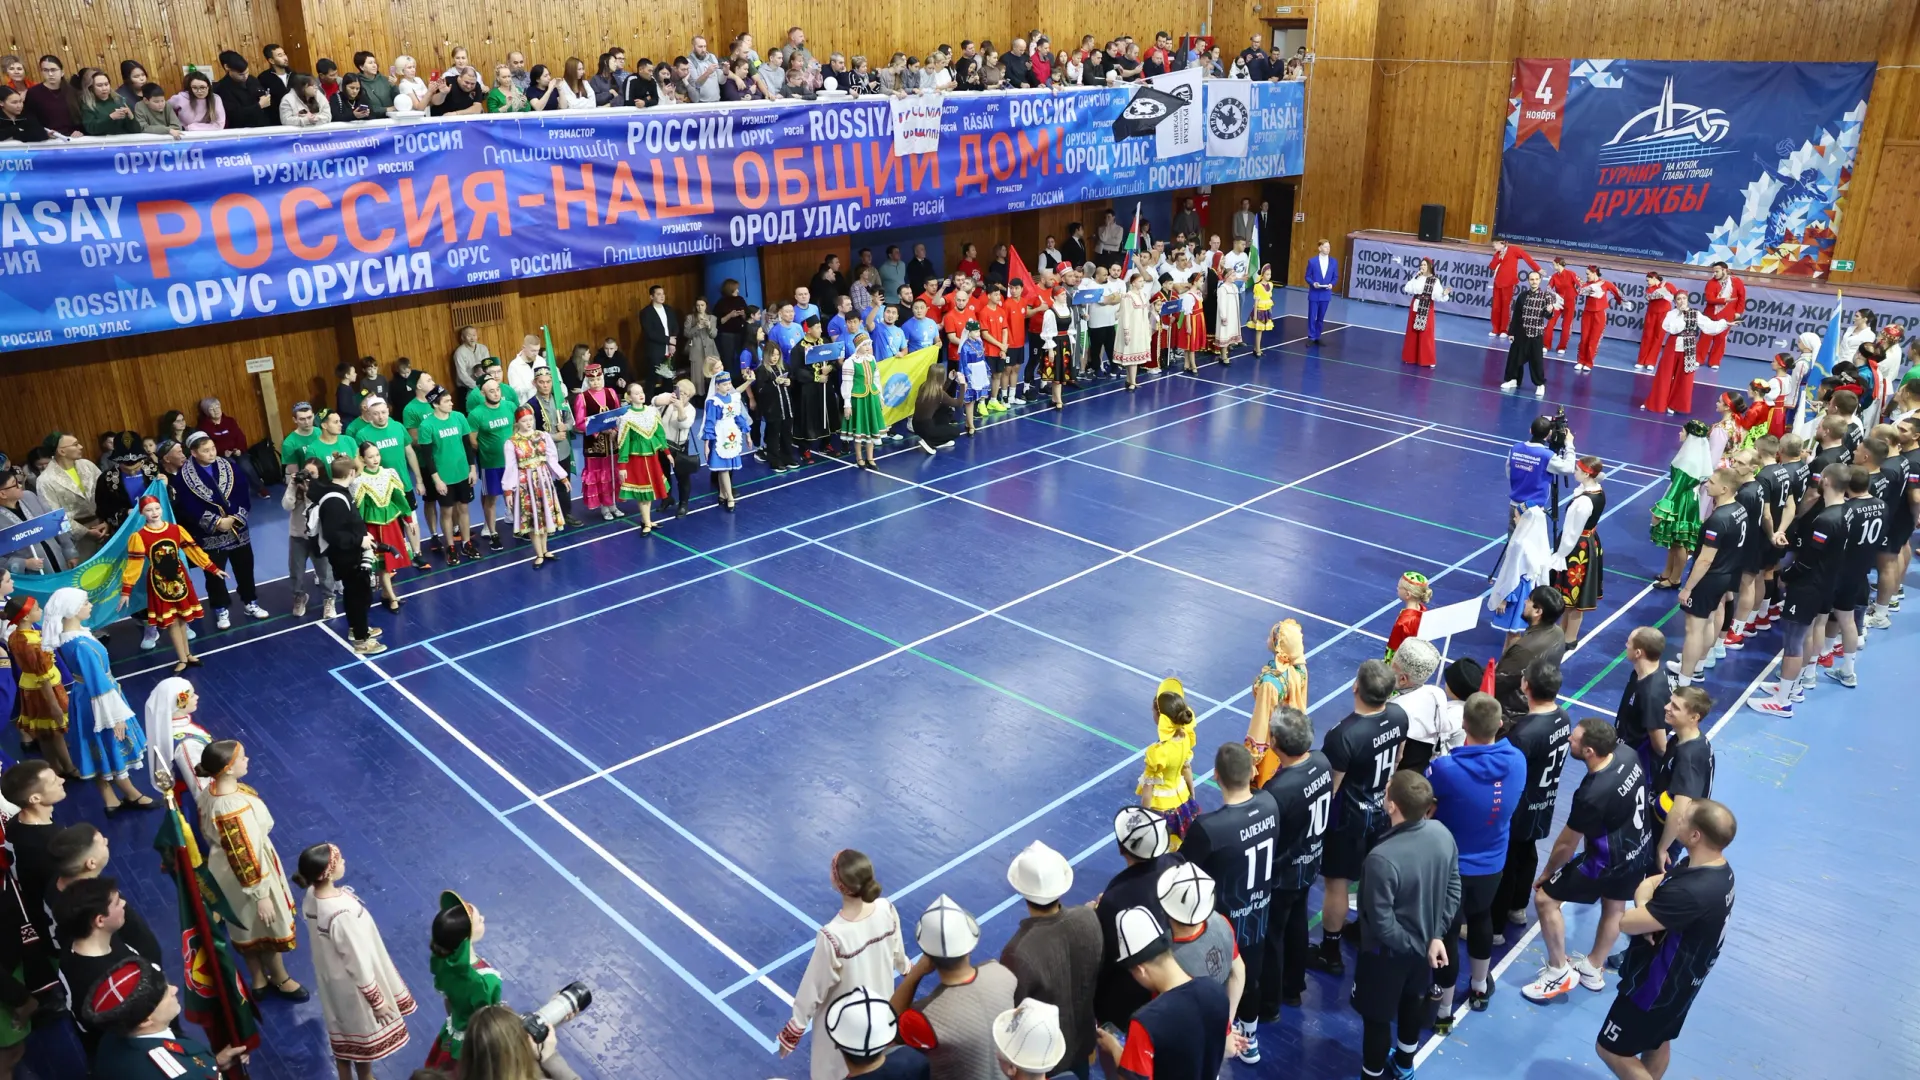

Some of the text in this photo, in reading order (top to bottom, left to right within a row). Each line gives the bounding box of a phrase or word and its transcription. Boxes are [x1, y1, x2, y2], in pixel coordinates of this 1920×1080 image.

[1535, 68, 1553, 104] 4
[741, 115, 779, 126] РУЗМАСТОР
[942, 105, 959, 115] АСТОР
[1009, 96, 1078, 128] РОССИЯ
[1262, 102, 1297, 130] RÄSÄY
[1526, 109, 1556, 122] ноября
[963, 112, 994, 131] RÄSÄY
[393, 129, 464, 155] РОССИЯ
[549, 128, 595, 140] РУЗМАСТОР
[627, 109, 734, 156] РОССИЙ
[741, 129, 775, 147] ОРУС
[1065, 131, 1097, 147] ОРУСИЯ
[114, 149, 206, 174] ОРУСИЯ
[377, 161, 415, 175] РОССИЯ
[955, 126, 1064, 197] ДОМ!
[1065, 141, 1150, 175] ОРОД УЛАС
[1239, 153, 1285, 178] ROSSIYA
[1665, 160, 1699, 171] НА КУБОК
[253, 155, 369, 186] РУЗМАСТОР
[1149, 156, 1202, 191] РОССИЙ
[1599, 163, 1662, 185] ТУРНИР
[1662, 168, 1713, 181] ГЛАВЫ ГОРОДА
[996, 184, 1023, 194] РУЗМАСТОР
[1031, 186, 1065, 207] РОССИЙ
[875, 196, 907, 207] РУЗМАСТОР
[1583, 182, 1711, 224] ДРУЖБЫ
[662, 221, 703, 235] РУЗМАСТОР
[730, 202, 861, 247] ОРОД УЛАС
[864, 211, 892, 230] ОРУС
[80, 241, 143, 268] ОРУС
[447, 244, 490, 268] ОРУС
[510, 247, 572, 277] РОССИЙ
[1358, 249, 1393, 264] СПОРТ
[467, 269, 500, 283] ОРУСИЯ
[1355, 277, 1398, 294] ЖИЗНИ
[1357, 264, 1400, 280] НОРМА
[1450, 276, 1489, 294] СПОРТ
[167, 251, 434, 325] ОРУС ОРУСИЯ
[54, 288, 157, 320] ROSSIYA
[1744, 298, 1795, 317] ОРМА
[1, 330, 53, 347] РОССИЯ
[63, 320, 131, 339] ОРОД УЛАС
[438, 427, 459, 438] ВАТАН
[489, 417, 510, 429] ВАТАН
[377, 438, 398, 449] ВАТАН
[1864, 510, 1882, 519] РУСЬ
[1796, 538, 1802, 547] 3
[1857, 518, 1883, 546] 10
[1881, 536, 1888, 546] 2
[1789, 604, 1796, 615] 4
[1373, 726, 1401, 748] САЛЕХАРД
[1372, 744, 1398, 789] 14
[1303, 770, 1332, 798] САЛЕХАРД
[1306, 790, 1331, 838] 10
[1240, 815, 1276, 842] САЛЕХАРД
[1245, 837, 1274, 890] 17
[1603, 1019, 1622, 1043] 15
